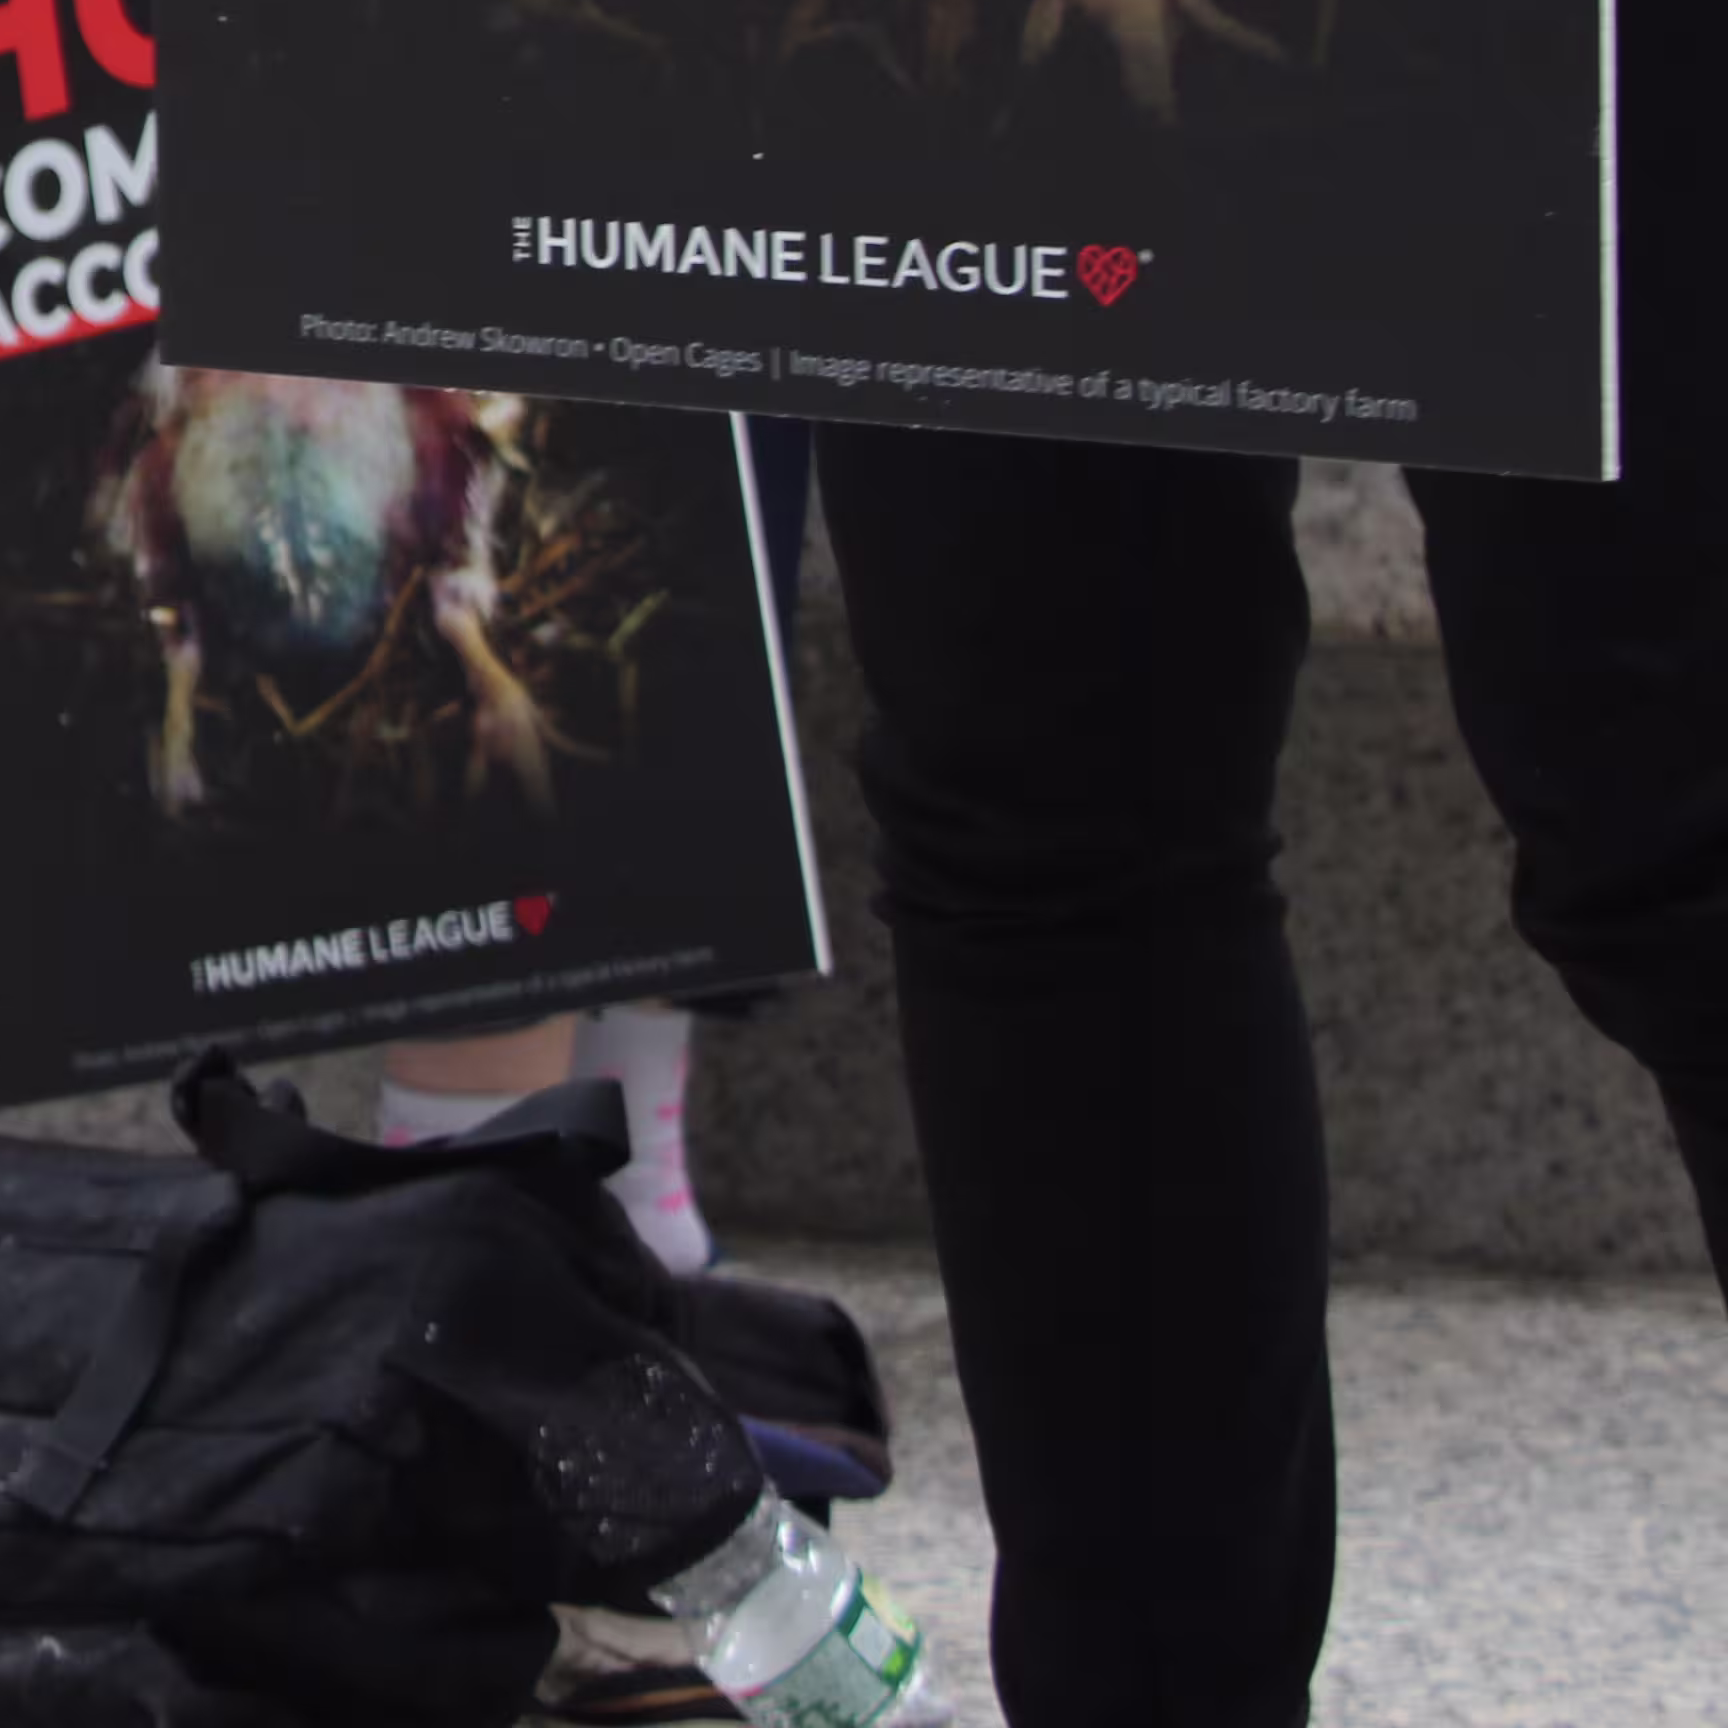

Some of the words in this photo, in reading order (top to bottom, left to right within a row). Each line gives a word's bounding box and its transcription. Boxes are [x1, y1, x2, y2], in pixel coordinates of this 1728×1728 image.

[537, 215, 808, 282] HUMANE
[818, 232, 1069, 300] LEAGUE
[300, 313, 378, 342] Photo:
[382, 320, 475, 349] Andrew
[479, 326, 589, 358] Skowron
[609, 336, 680, 370] Open
[685, 342, 763, 377] Cages
[790, 349, 871, 386] Image
[876, 360, 1073, 395] representative
[1077, 370, 1111, 398] of
[1113, 378, 1132, 400] a
[1138, 377, 1231, 411] typical
[1236, 380, 1340, 423] factory
[1344, 387, 1417, 421] farm
[204, 928, 365, 992] HUMANE
[368, 901, 512, 962] LEAGUE
